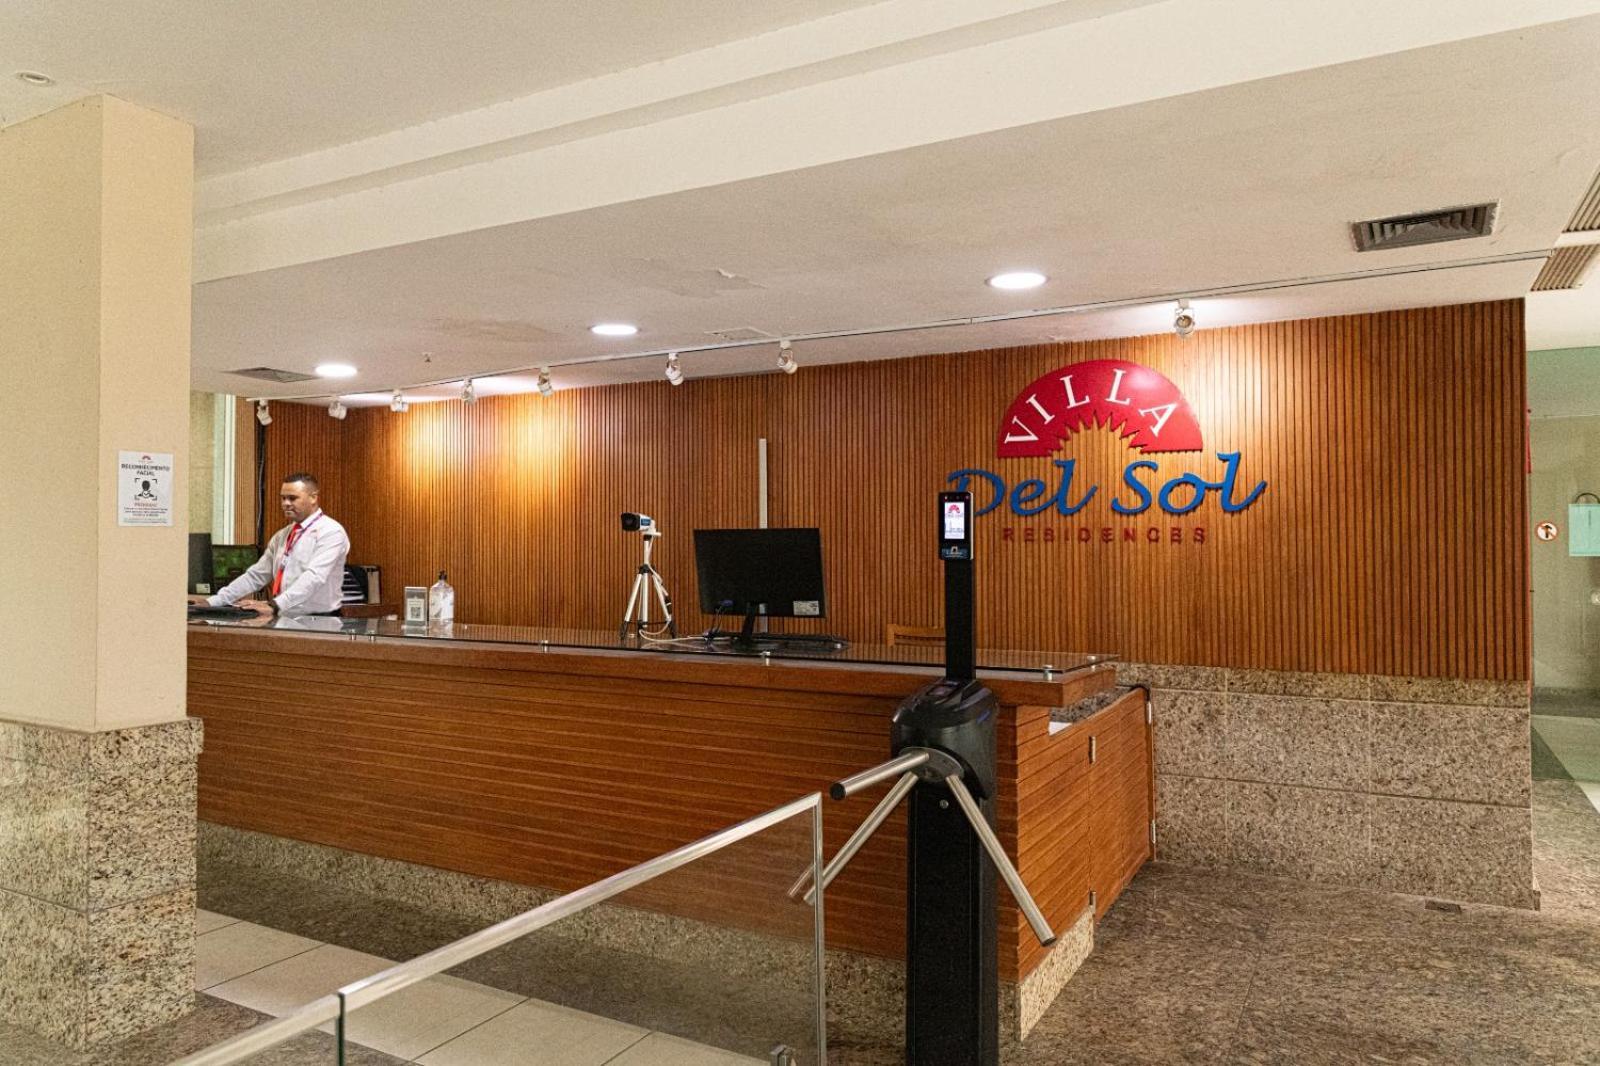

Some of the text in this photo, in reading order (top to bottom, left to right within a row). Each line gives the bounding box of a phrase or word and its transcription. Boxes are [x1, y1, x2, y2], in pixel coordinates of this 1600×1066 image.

[1005, 368, 1177, 443] VILLA
[947, 451, 1267, 515] Del Sol
[1003, 527, 1206, 544] RESIDENCES
